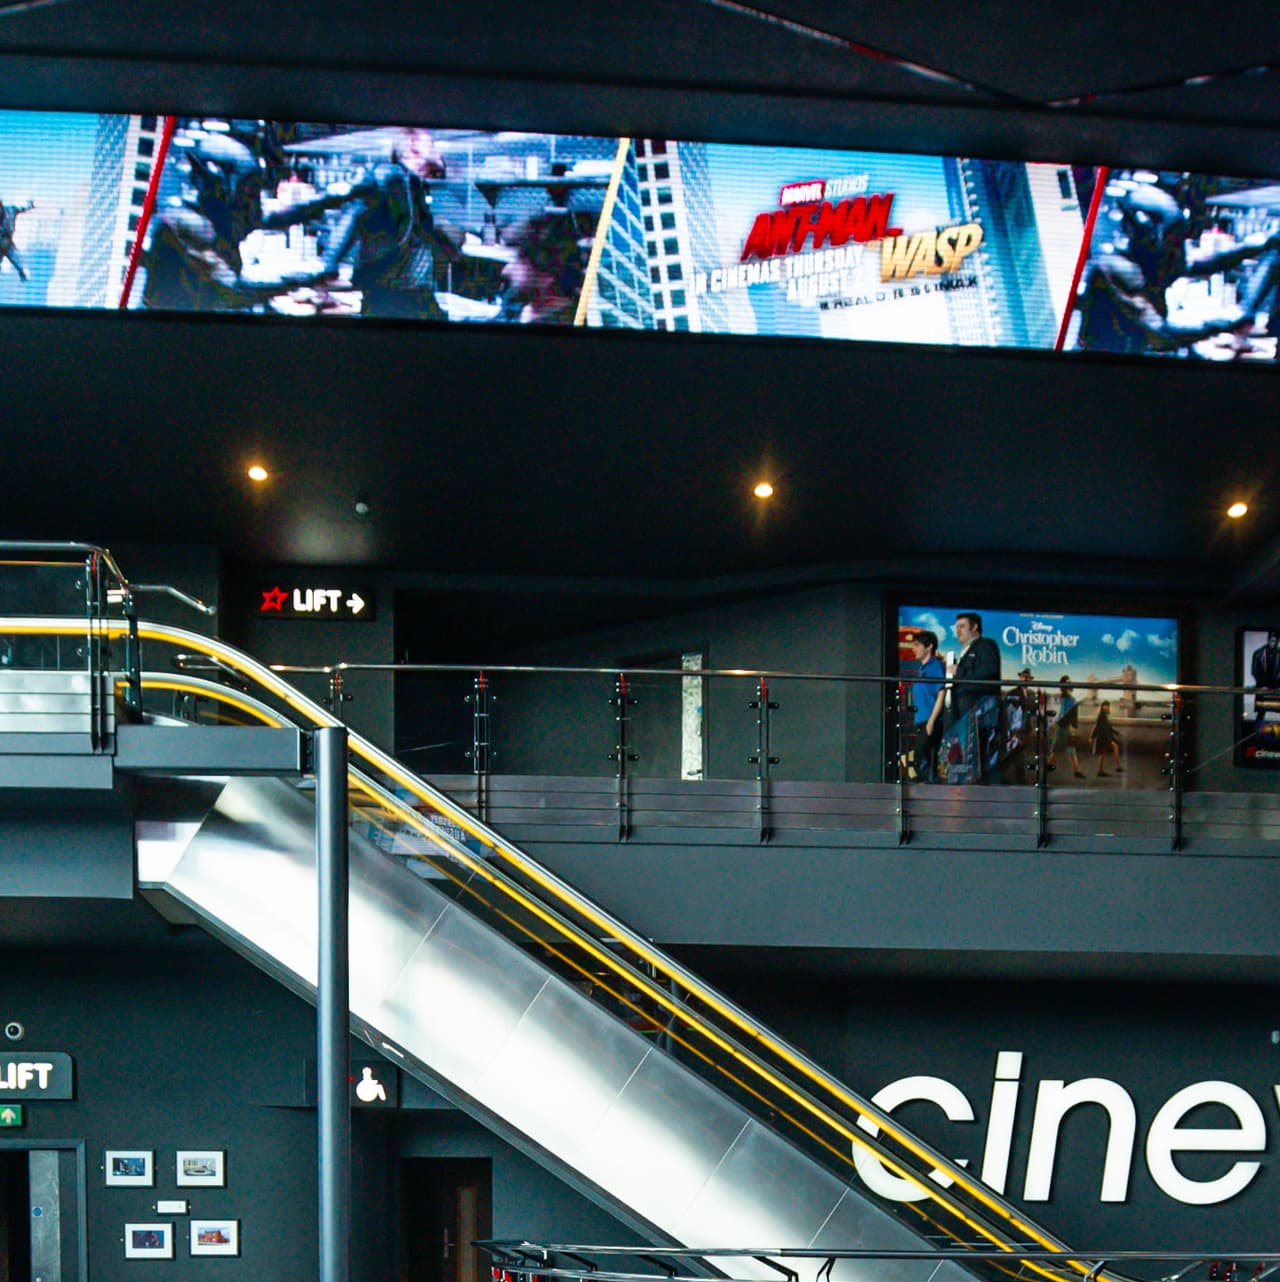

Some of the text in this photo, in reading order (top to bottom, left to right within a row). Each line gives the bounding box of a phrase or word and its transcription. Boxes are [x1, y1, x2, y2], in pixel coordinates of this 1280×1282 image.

[881, 223, 983, 283] WASP
[711, 259, 781, 292] CINEMAS
[785, 244, 864, 278] THURSDAY
[787, 268, 849, 300] AUGUST
[293, 588, 342, 612] LIFT
[1002, 626, 1080, 649] Christopher
[1022, 645, 1069, 666] Robin
